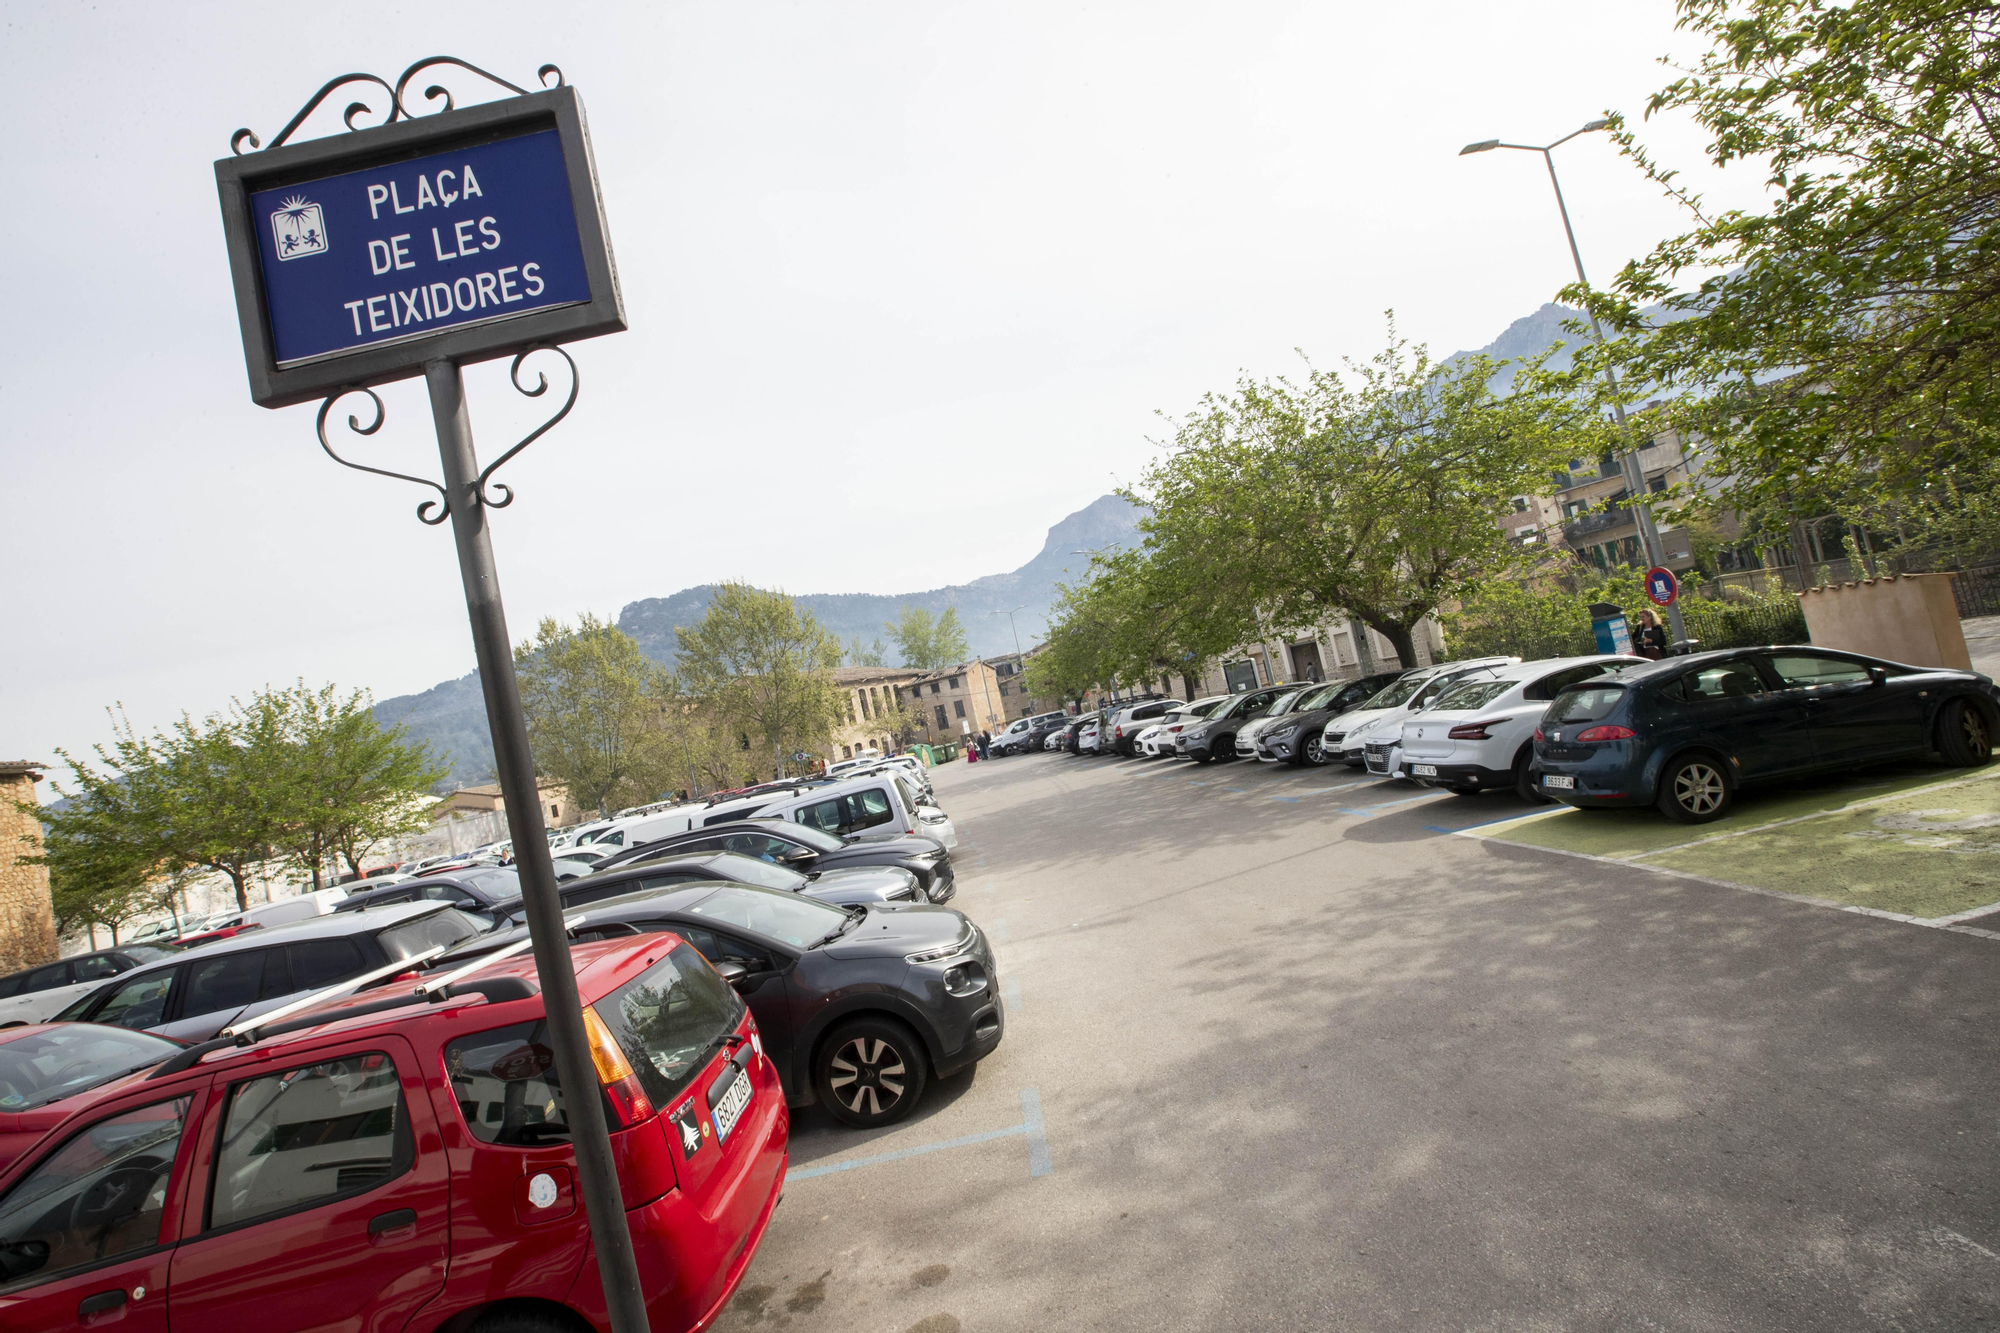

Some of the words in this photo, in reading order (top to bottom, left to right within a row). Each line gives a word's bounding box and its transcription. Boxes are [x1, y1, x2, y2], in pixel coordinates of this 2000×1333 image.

[367, 165, 483, 219] PLAÇA
[368, 234, 416, 276] DE
[432, 216, 501, 261] LES
[344, 262, 545, 336] TEIXIDORES
[717, 1092, 737, 1128] 6821
[734, 1072, 751, 1103] DGR
